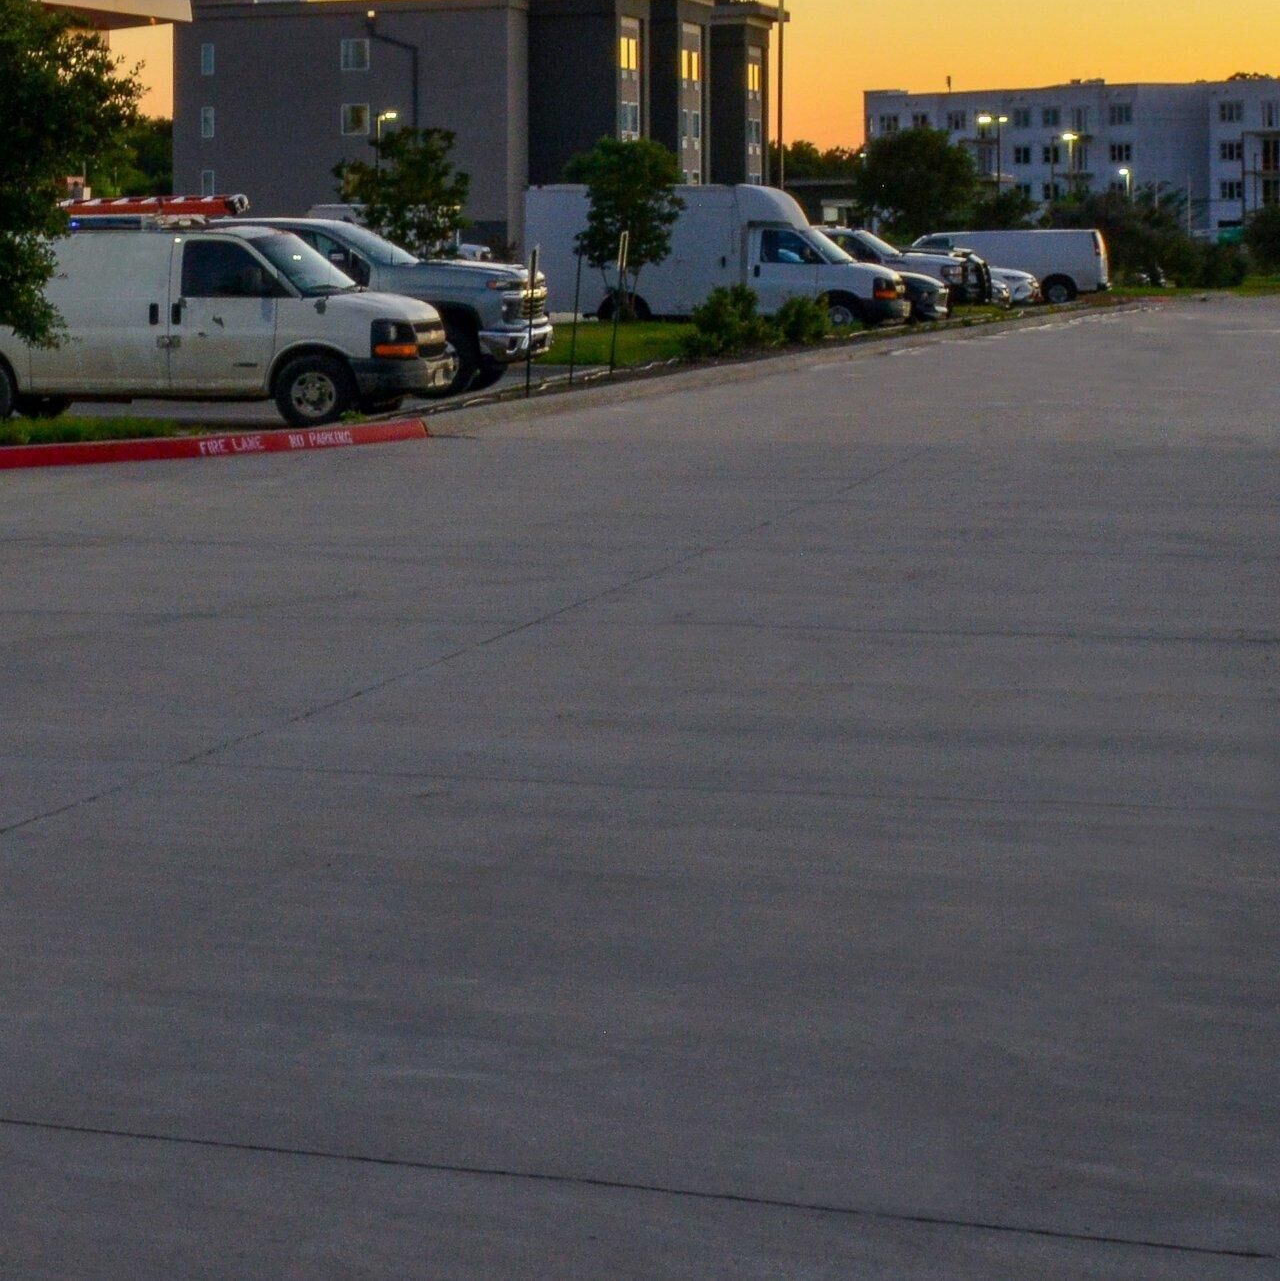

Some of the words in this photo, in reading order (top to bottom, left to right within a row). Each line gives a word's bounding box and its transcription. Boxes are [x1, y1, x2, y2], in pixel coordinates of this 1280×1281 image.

[199, 439, 228, 455] FIRE
[232, 436, 265, 451] LANE
[289, 434, 305, 448] NO
[309, 431, 352, 446] PARKING
